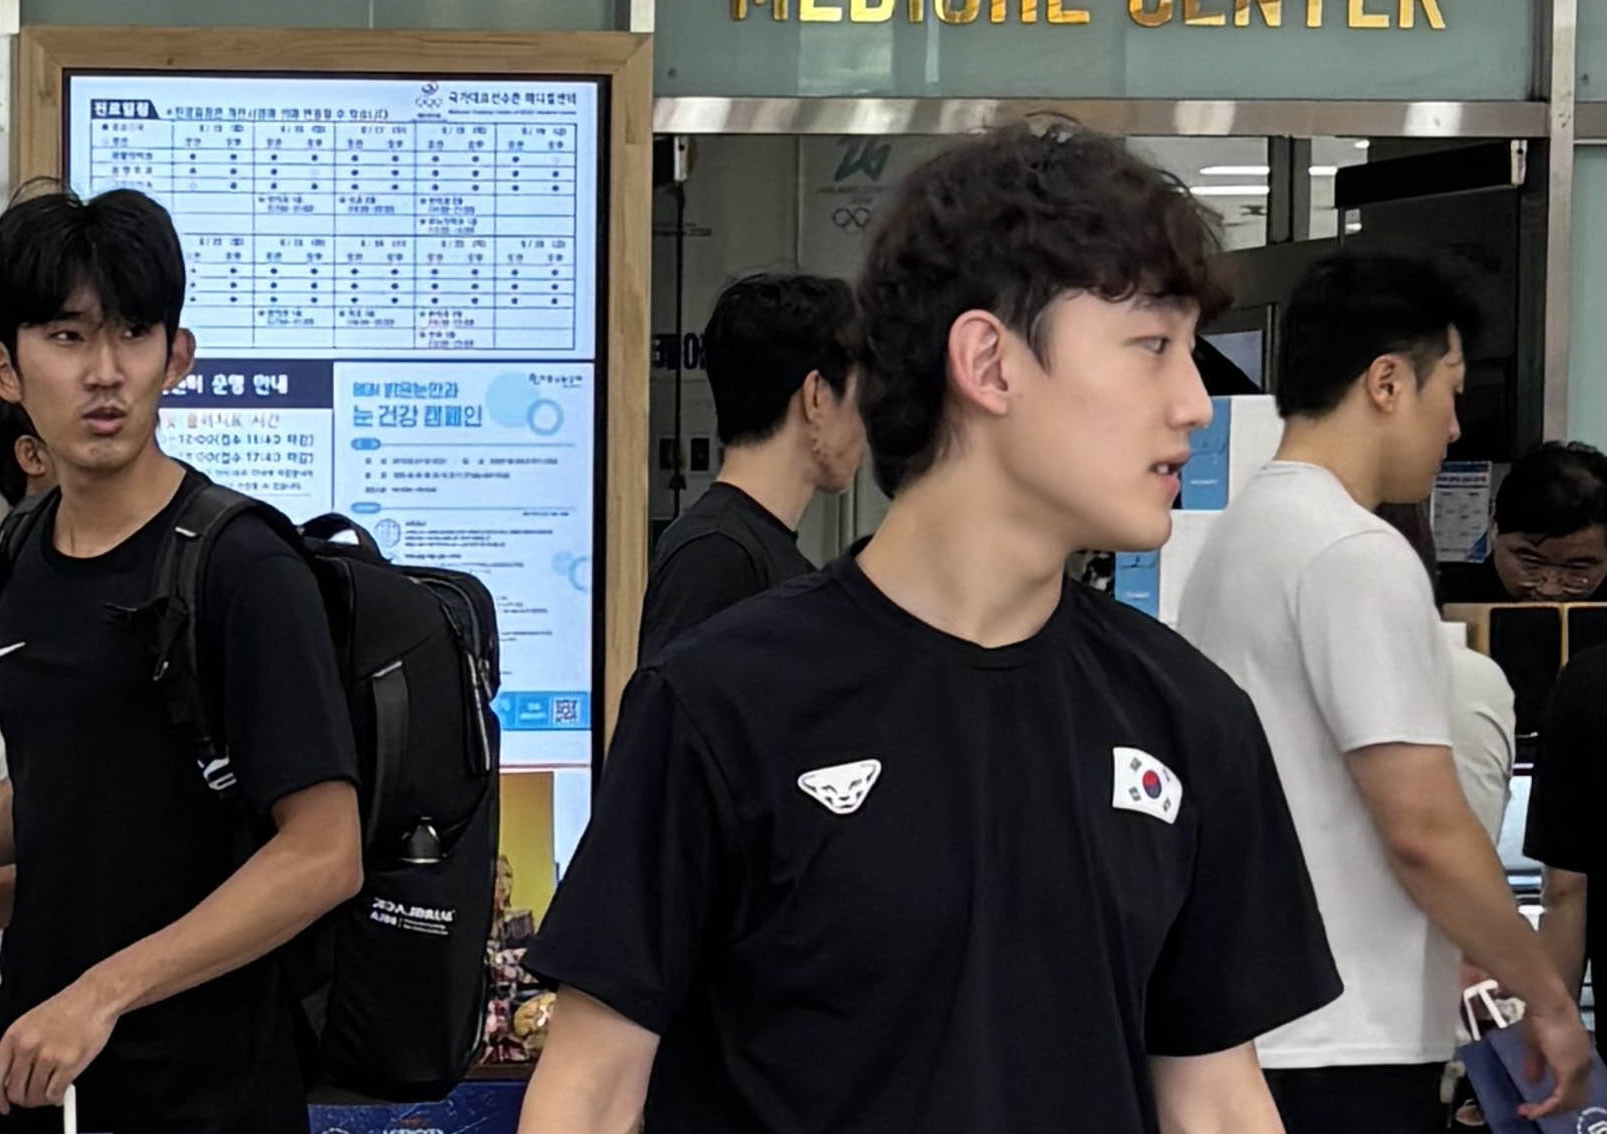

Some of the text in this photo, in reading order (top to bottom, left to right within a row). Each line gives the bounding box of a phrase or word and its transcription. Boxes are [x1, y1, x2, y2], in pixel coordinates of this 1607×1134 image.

[212, 374, 245, 395] 운영
[253, 374, 289, 395] 안내
[353, 405, 483, 428] 눈 건강 캠페인
